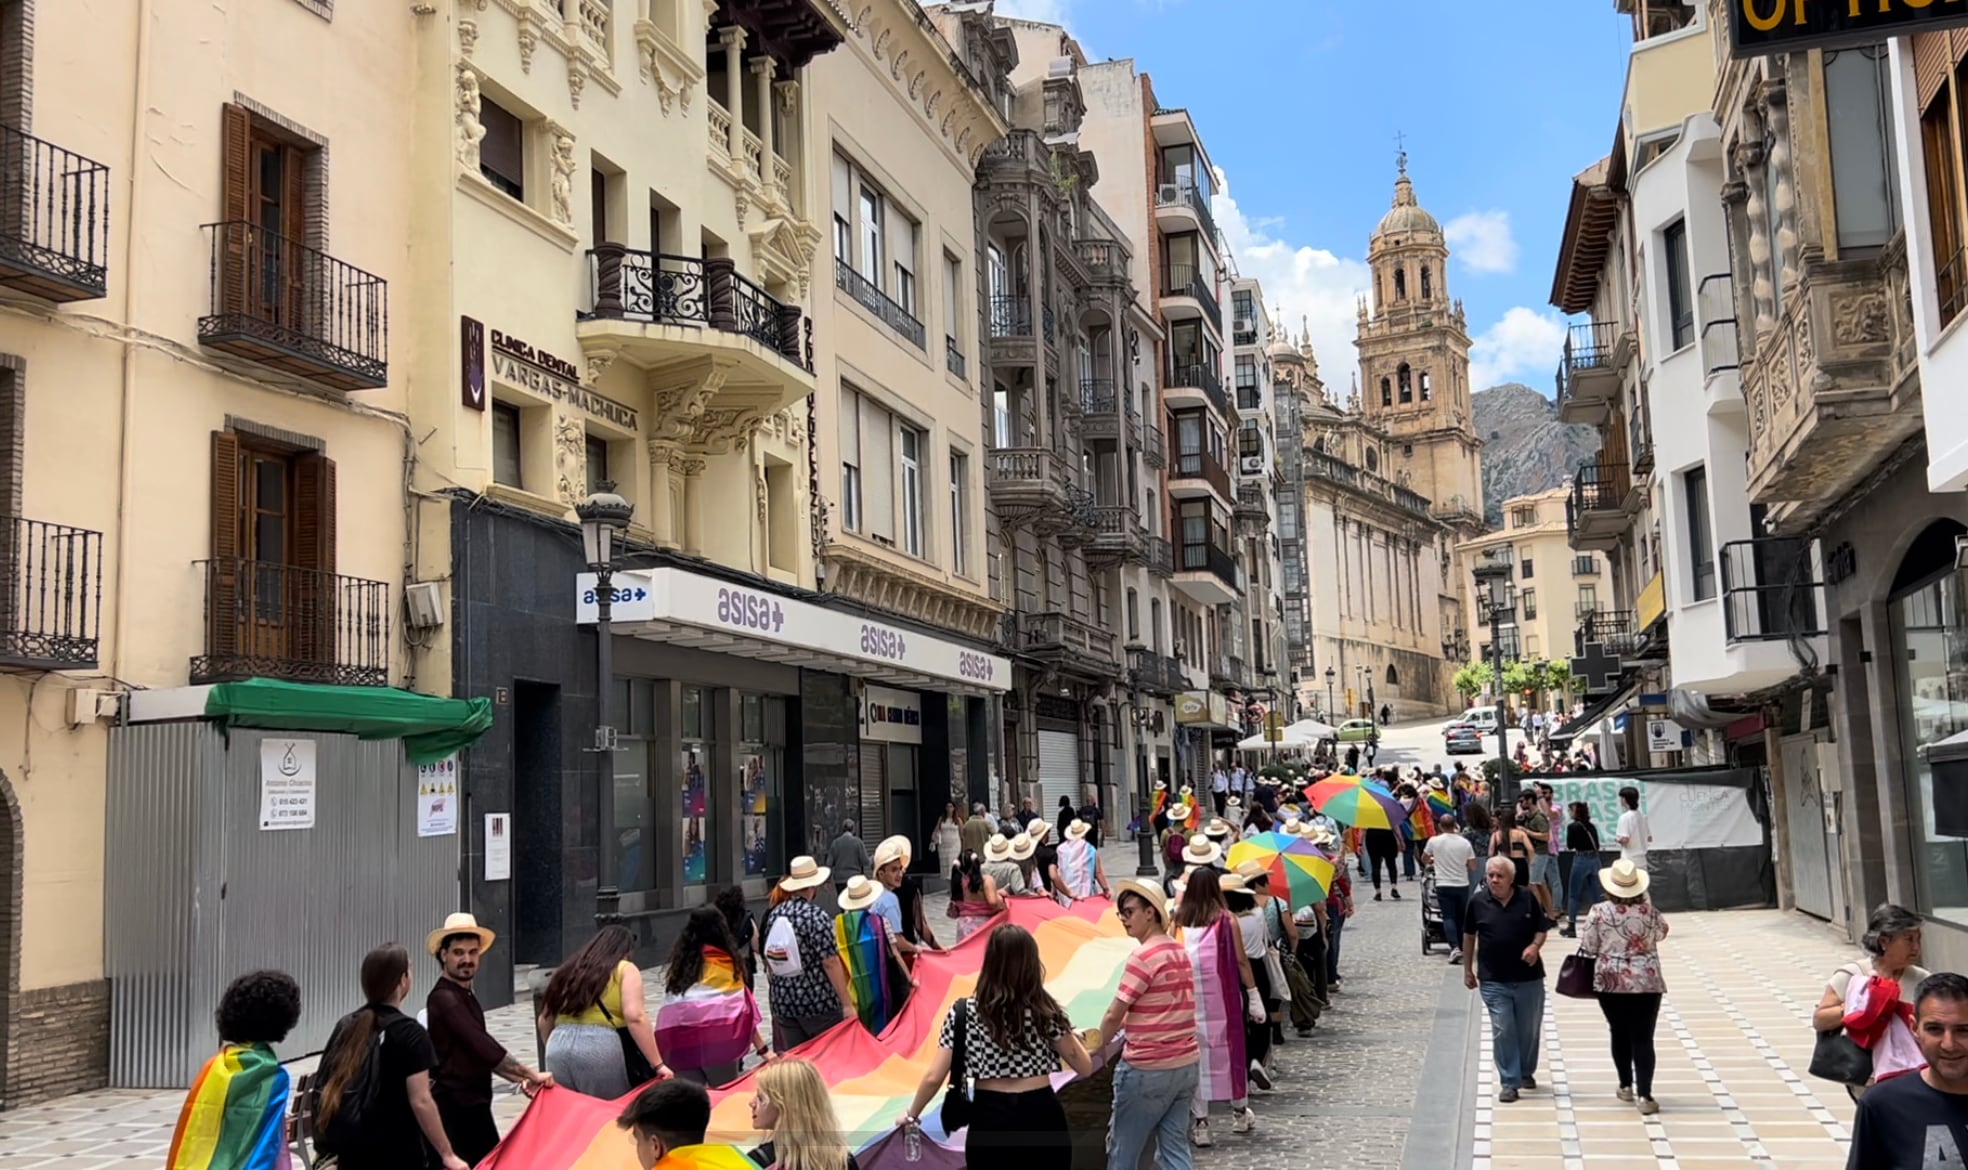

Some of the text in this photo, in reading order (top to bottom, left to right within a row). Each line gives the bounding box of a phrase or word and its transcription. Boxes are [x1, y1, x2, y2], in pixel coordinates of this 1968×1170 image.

[537, 350, 581, 380] DENTAL
[491, 353, 639, 432] VARGAS-MACHUCA
[717, 587, 771, 631] asisa
[861, 624, 897, 660] asisa
[959, 651, 986, 680] asisa
